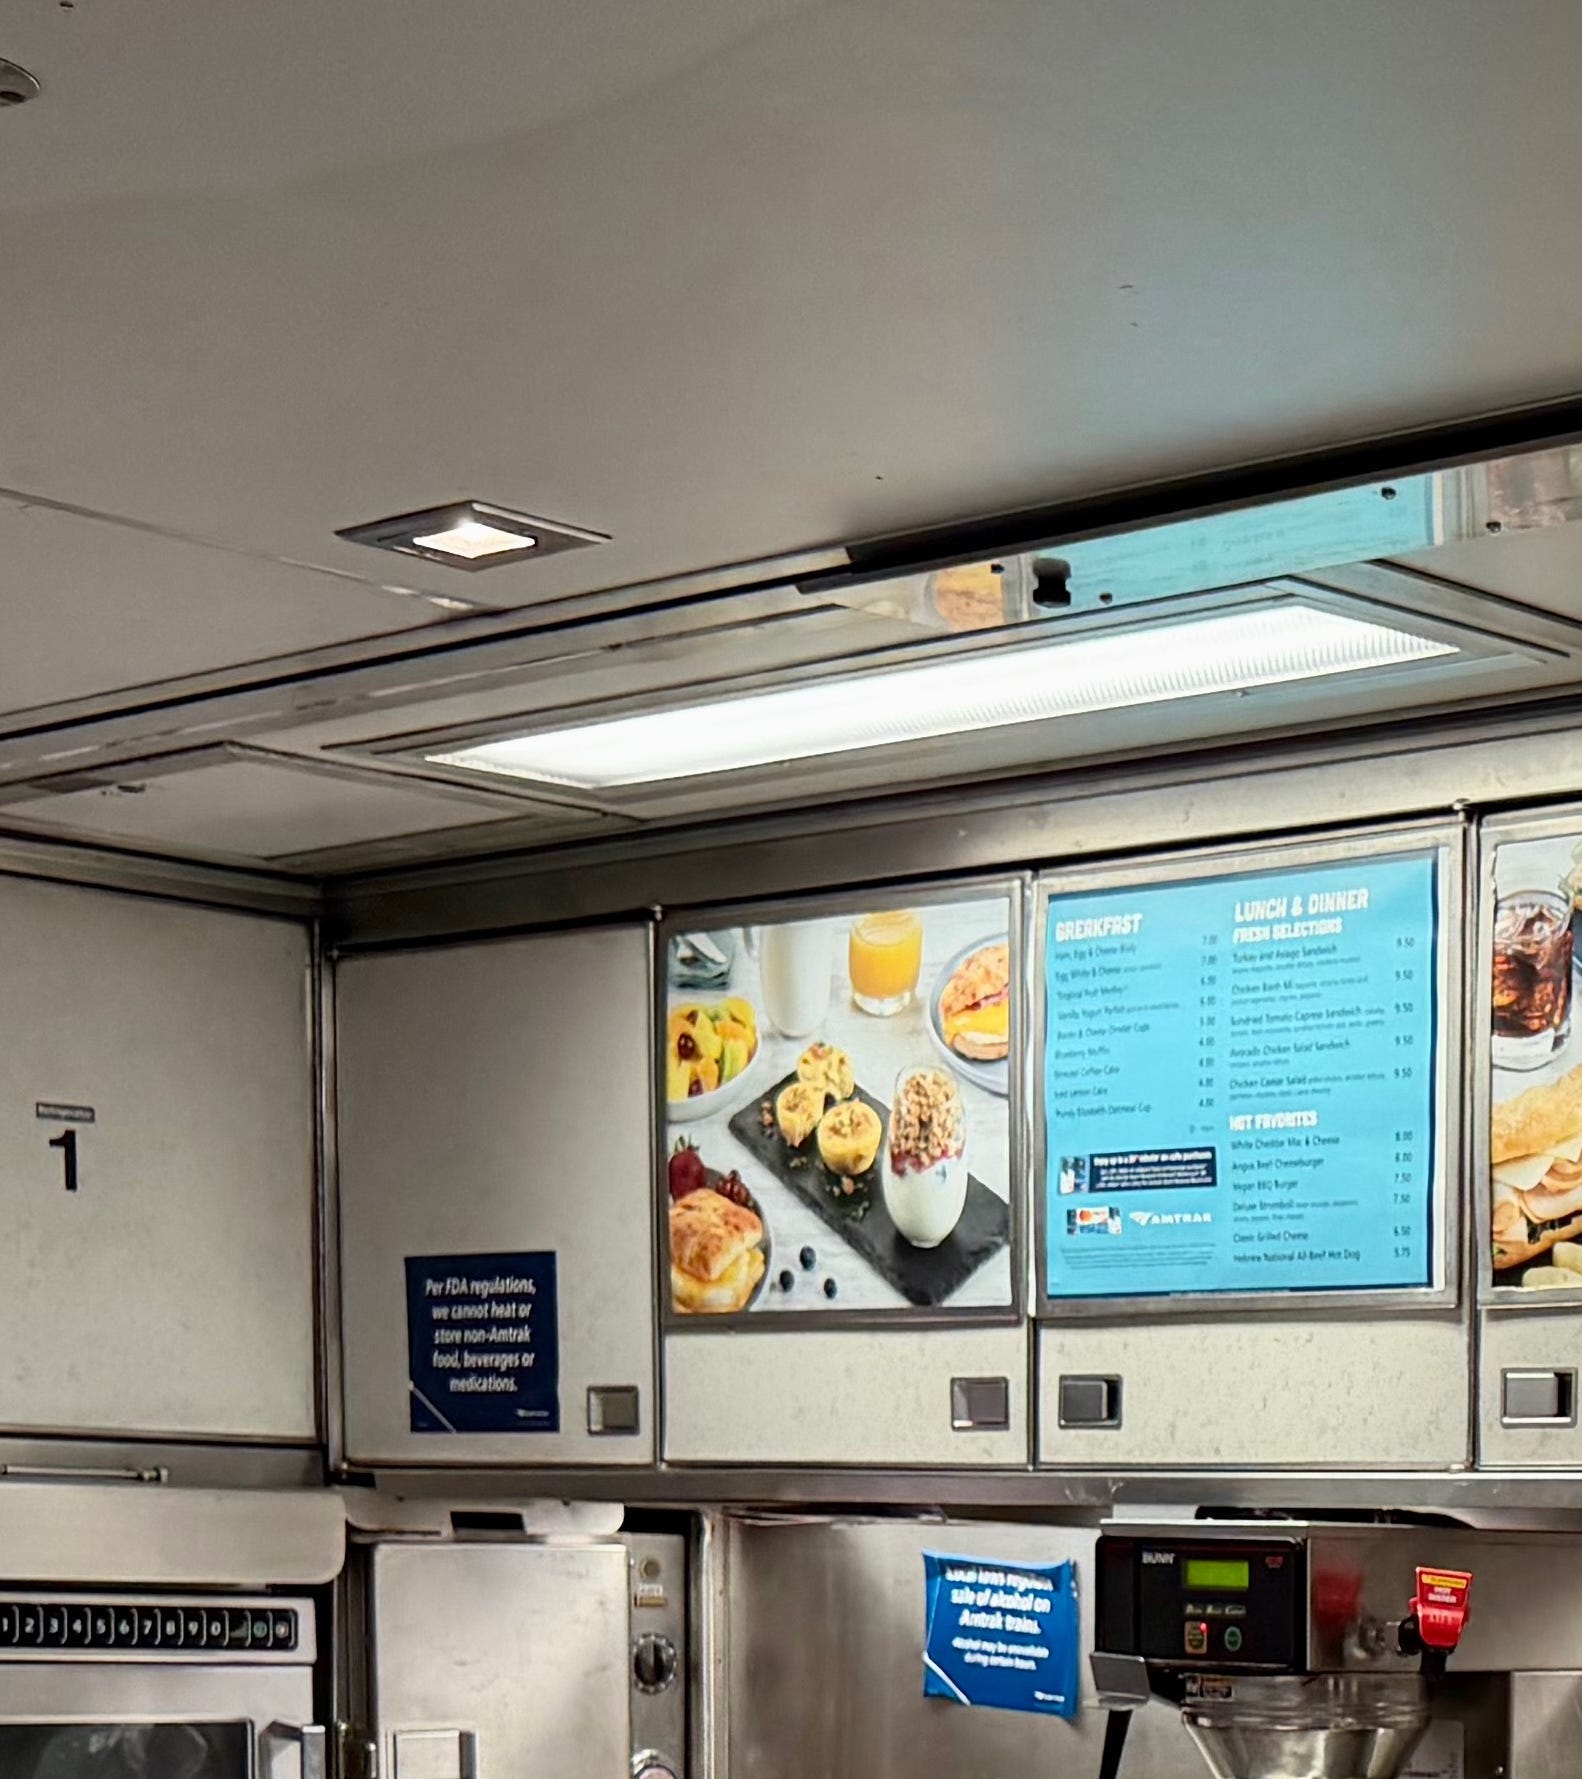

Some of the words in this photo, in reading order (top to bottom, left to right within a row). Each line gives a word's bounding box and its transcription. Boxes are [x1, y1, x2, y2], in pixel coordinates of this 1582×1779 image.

[1235, 897, 1286, 921] LUNCH
[1308, 888, 1368, 914] DINNER
[1056, 913, 1141, 940] BREAKFAST
[49, 1129, 77, 1191] 1
[426, 1279, 443, 1295] Per
[445, 1278, 467, 1294] FDA
[470, 1277, 535, 1297] regulations,
[432, 1306, 449, 1319] we
[451, 1303, 488, 1318] cannot
[490, 1301, 515, 1318] heat
[518, 1303, 531, 1317] or
[434, 1329, 461, 1343] store
[464, 1325, 530, 1342] non-Amtrak
[433, 1351, 460, 1368] food,
[463, 1351, 519, 1371] beverages
[521, 1352, 534, 1366] or
[25, 1617, 34, 1633] 2
[143, 1619, 152, 1635] 7
